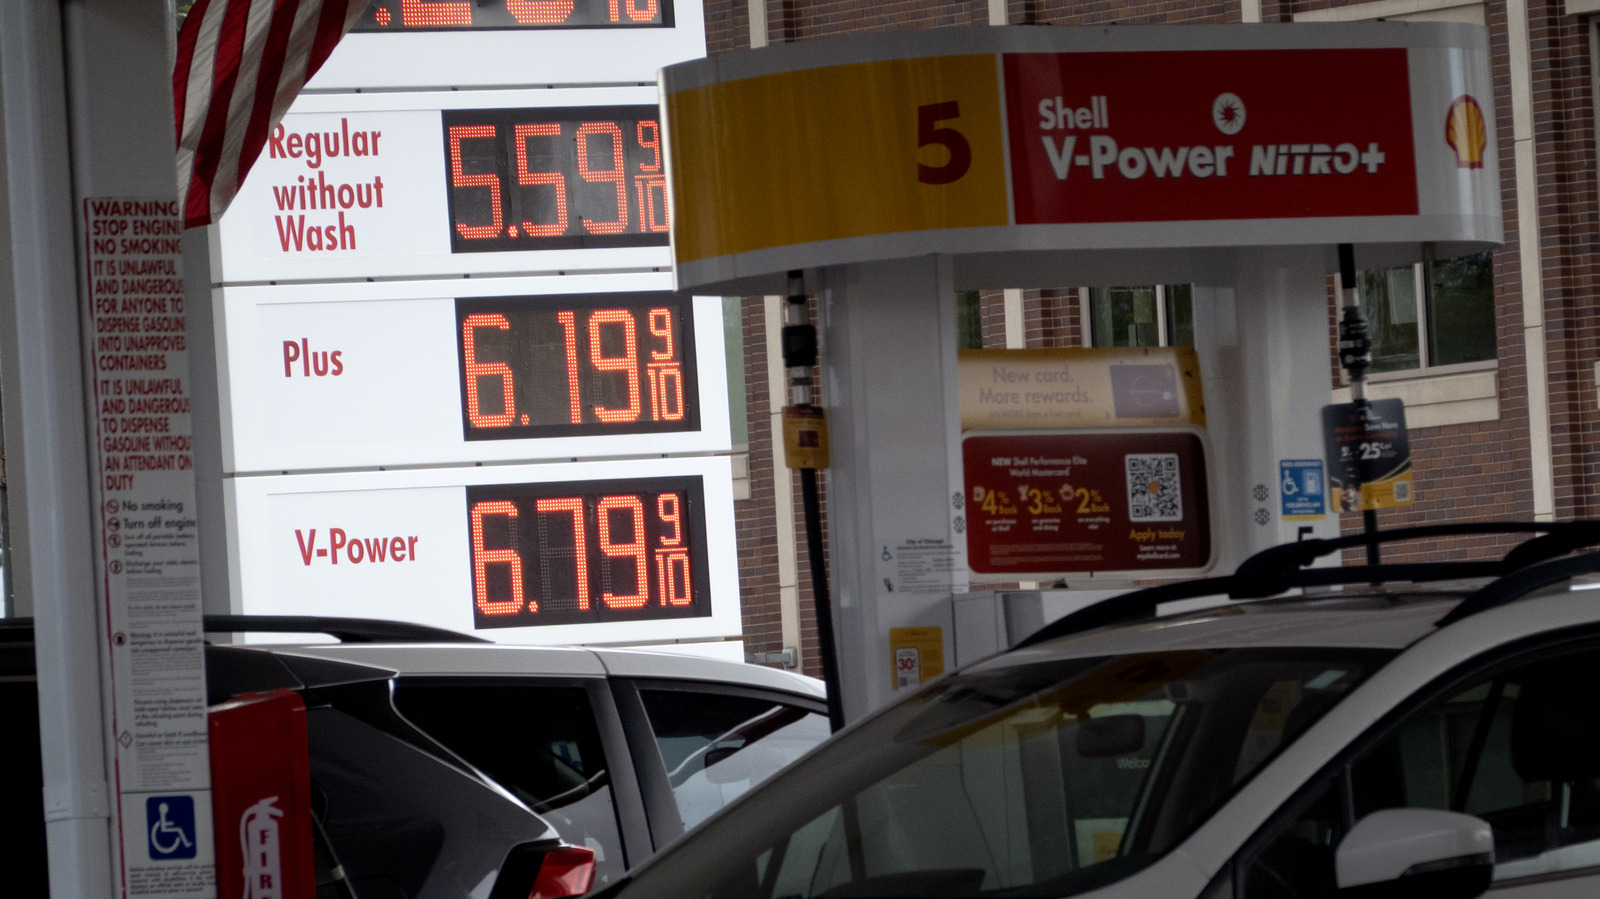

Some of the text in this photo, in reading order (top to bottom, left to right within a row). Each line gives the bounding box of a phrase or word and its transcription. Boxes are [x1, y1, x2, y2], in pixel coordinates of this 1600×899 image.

[1038, 95, 1109, 130] Shell
[268, 118, 381, 168] Regular
[917, 100, 972, 185] 5
[1040, 135, 1235, 181] V-Power
[449, 122, 629, 238] 5.59
[272, 171, 384, 210] without
[93, 220, 128, 236] STOP
[275, 210, 356, 252] Wash
[94, 238, 116, 255] NO
[94, 259, 177, 276] IT IS UNLAWFUL
[95, 279, 119, 295] AND
[96, 297, 184, 314] FOR ANYONE TO
[97, 317, 140, 333] DISPENSE
[98, 336, 121, 352] INTO
[99, 354, 167, 371] CONTAINERS
[282, 337, 343, 378] Plus
[463, 309, 640, 428] 6.19
[992, 364, 1075, 384] New card.
[100, 378, 183, 396] IT IS UNLAWFUL
[979, 385, 1093, 404] More rewards.
[102, 399, 126, 415] AND
[102, 417, 170, 434] TO DISPENSE
[103, 437, 150, 453] GASOLINE
[105, 454, 192, 472] AN ATTENDANT ON
[106, 475, 134, 491] DUTY
[122, 499, 183, 513] No smoking
[123, 517, 144, 529] Turn
[148, 516, 161, 529] off
[1128, 527, 1185, 542] Apply today
[294, 528, 418, 567] V-Power
[471, 495, 649, 616] 6.79
[1116, 757, 1152, 769] Welco
